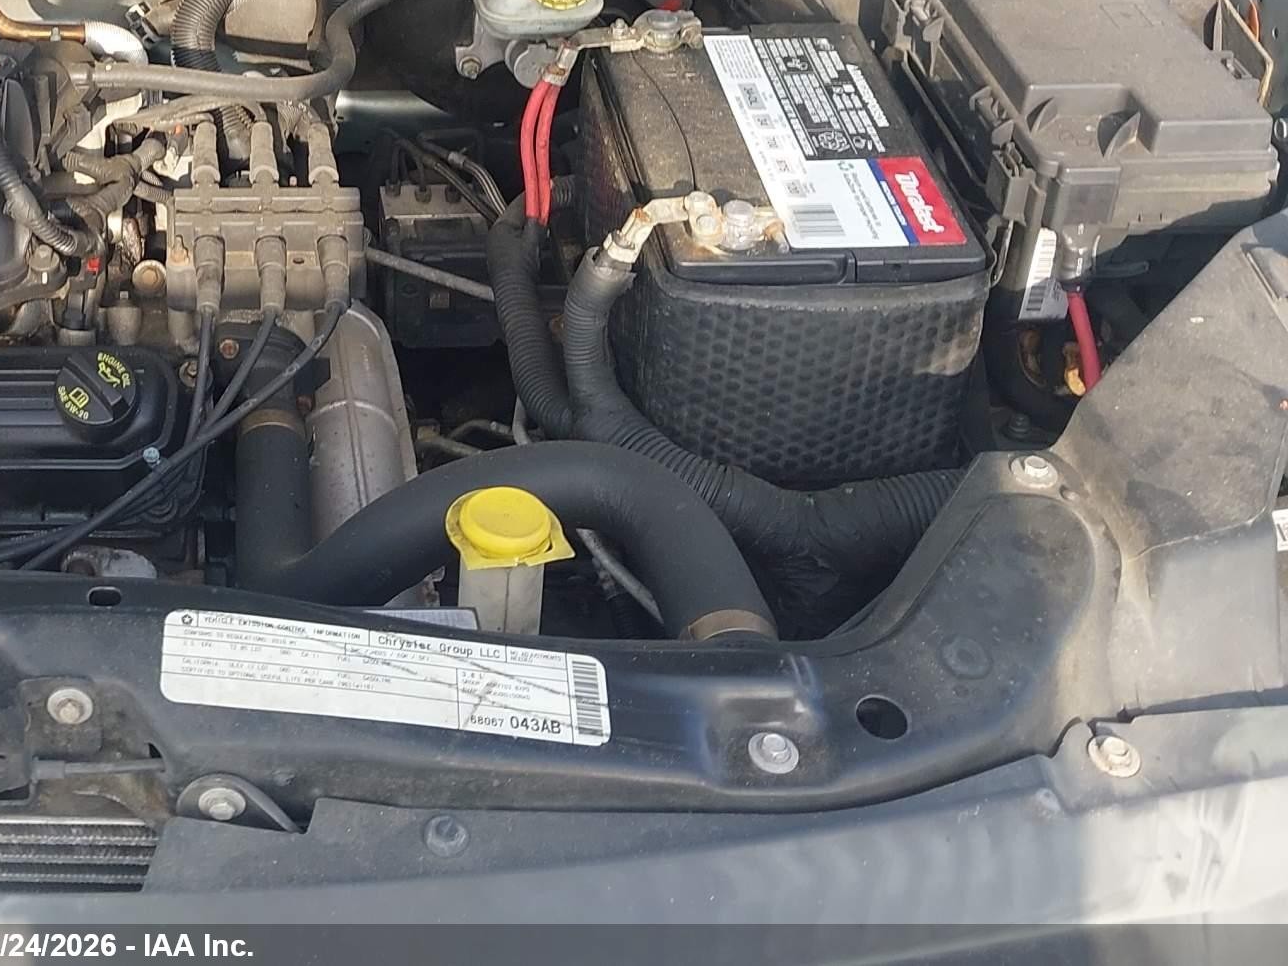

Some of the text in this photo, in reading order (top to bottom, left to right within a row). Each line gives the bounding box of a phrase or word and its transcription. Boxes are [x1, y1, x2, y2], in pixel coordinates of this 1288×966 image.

[894, 170, 945, 234] Duralast
[97, 352, 131, 389] ENGINE OIL
[58, 385, 69, 402] SAE
[378, 635, 430, 653] Chrysler
[439, 642, 472, 658] Group
[479, 647, 500, 658] LLC
[470, 714, 561, 734] 68067 043AB
